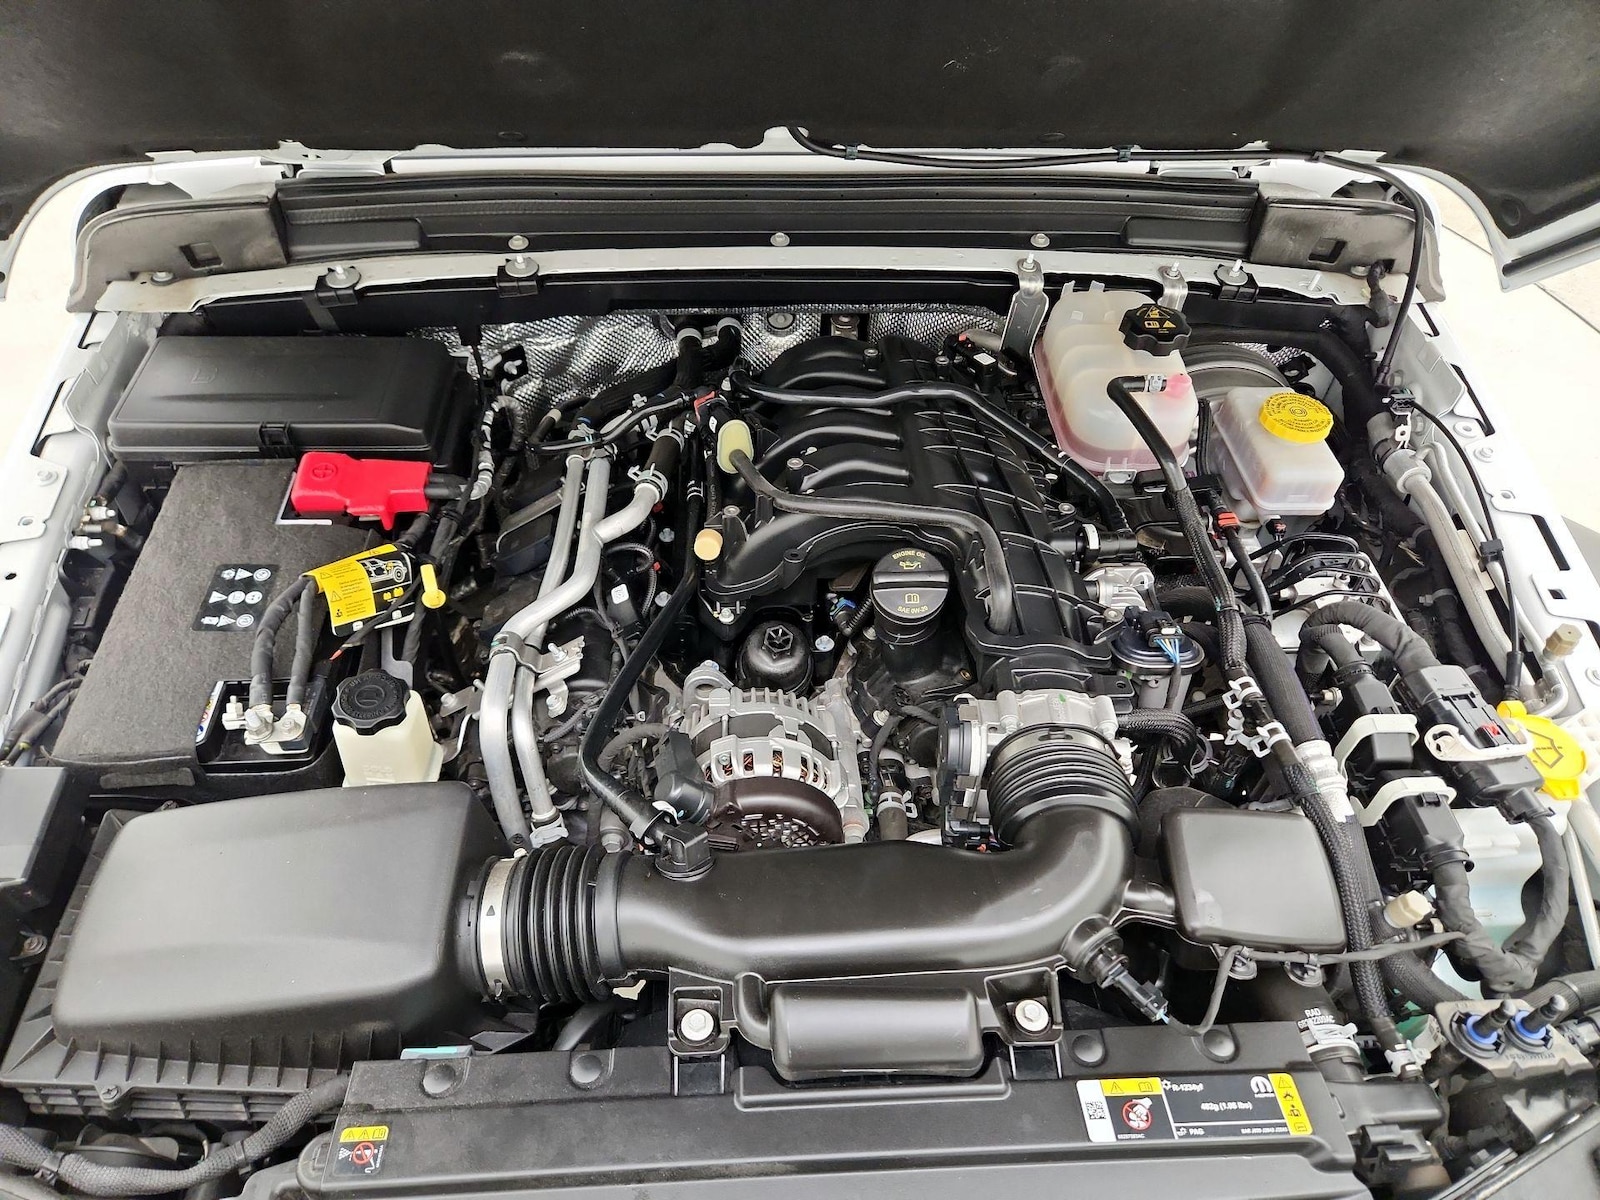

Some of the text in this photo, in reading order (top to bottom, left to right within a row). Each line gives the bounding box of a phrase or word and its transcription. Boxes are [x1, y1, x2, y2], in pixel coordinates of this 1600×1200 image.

[892, 550, 926, 560] ENGINE OIL
[1304, 1007, 1321, 1018] RAD
